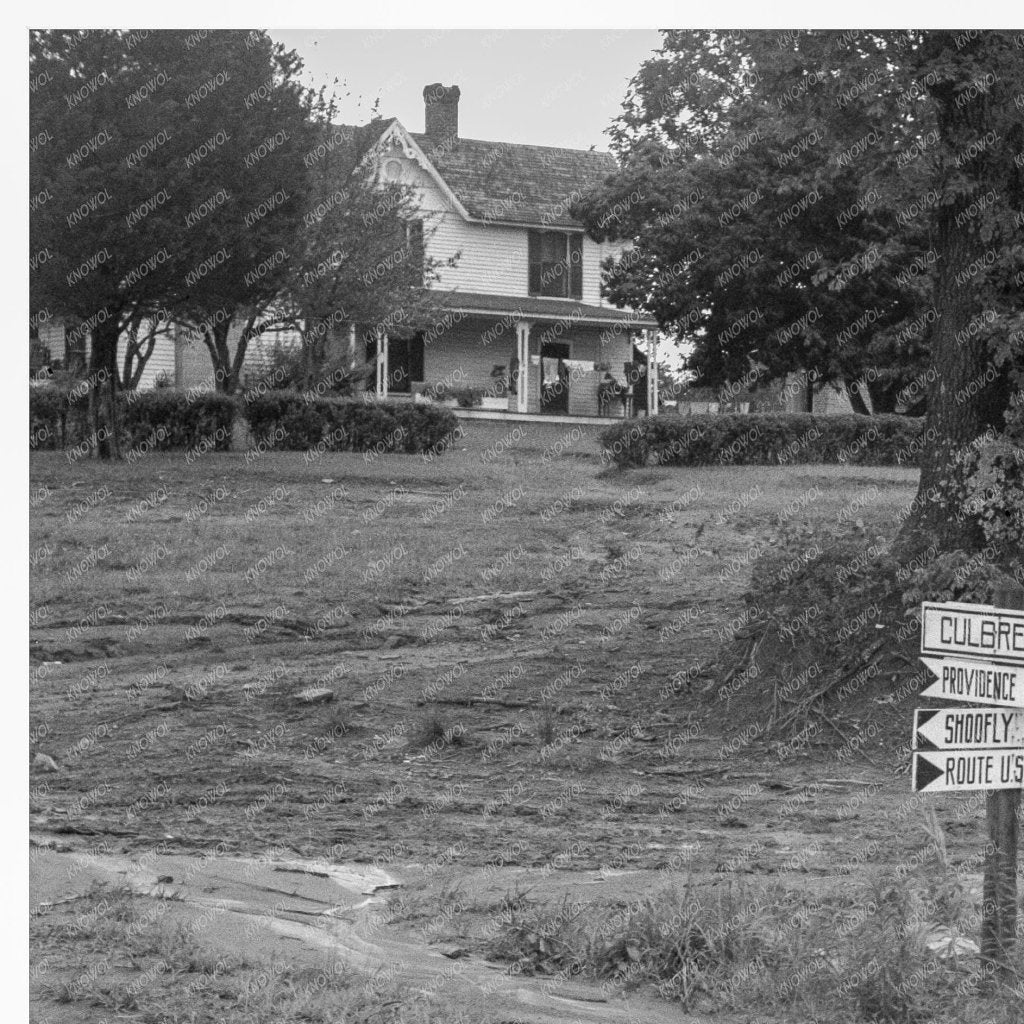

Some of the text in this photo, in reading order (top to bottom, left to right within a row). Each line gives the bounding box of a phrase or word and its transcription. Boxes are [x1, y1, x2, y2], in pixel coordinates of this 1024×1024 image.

[942, 666, 1017, 701] PROVIDENCE
[944, 713, 1015, 743] SHOOFLY
[945, 756, 993, 785] ROUTE
